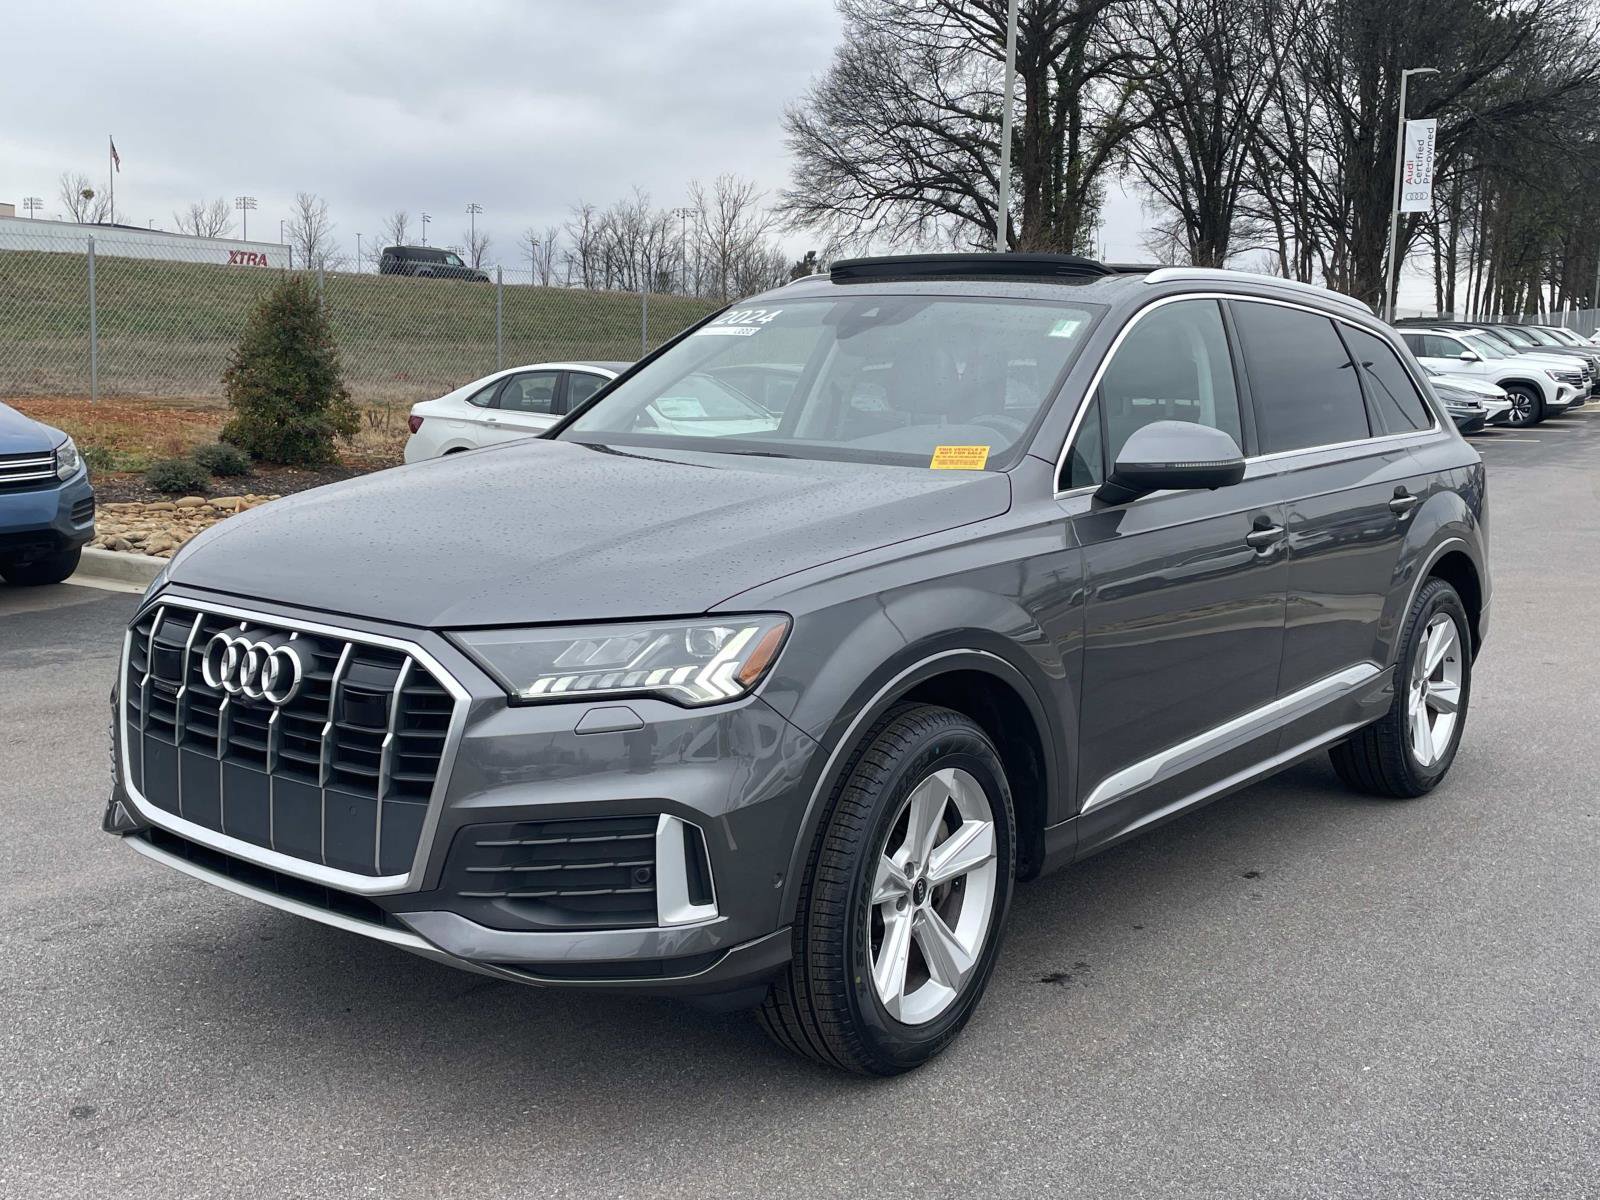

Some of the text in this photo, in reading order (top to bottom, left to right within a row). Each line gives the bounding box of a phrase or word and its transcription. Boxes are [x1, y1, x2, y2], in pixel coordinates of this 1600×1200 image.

[1414, 139, 1425, 185] Certified
[1423, 127, 1434, 184] Pre-owned
[1406, 160, 1414, 185] Audi
[228, 250, 268, 267] XTRA
[711, 310, 784, 325] 2024
